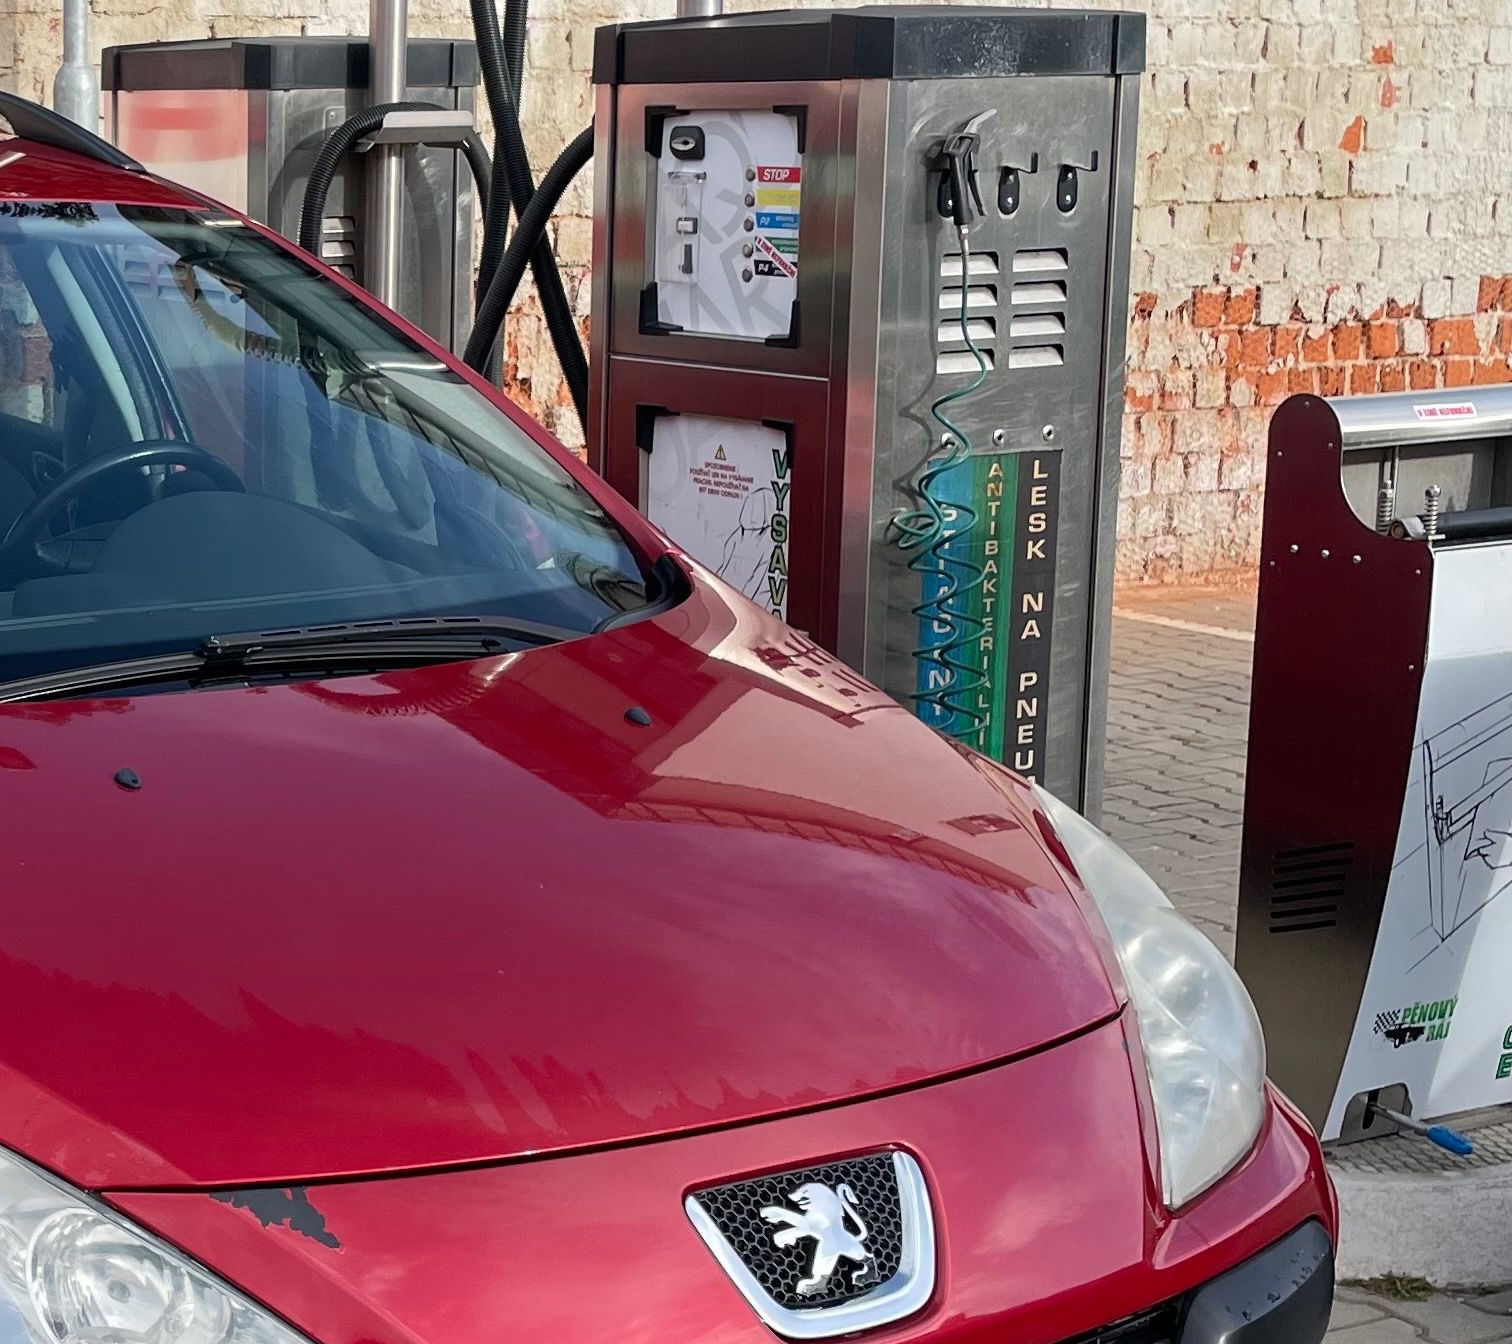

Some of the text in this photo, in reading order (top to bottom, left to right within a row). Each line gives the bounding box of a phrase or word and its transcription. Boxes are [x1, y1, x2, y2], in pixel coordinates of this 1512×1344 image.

[763, 168, 790, 181] STOP
[1026, 459, 1049, 560] LESK
[1021, 592, 1044, 640] NA
[1402, 994, 1459, 1024] PĚNOVÝ
[1426, 1019, 1451, 1042] RÁJ
